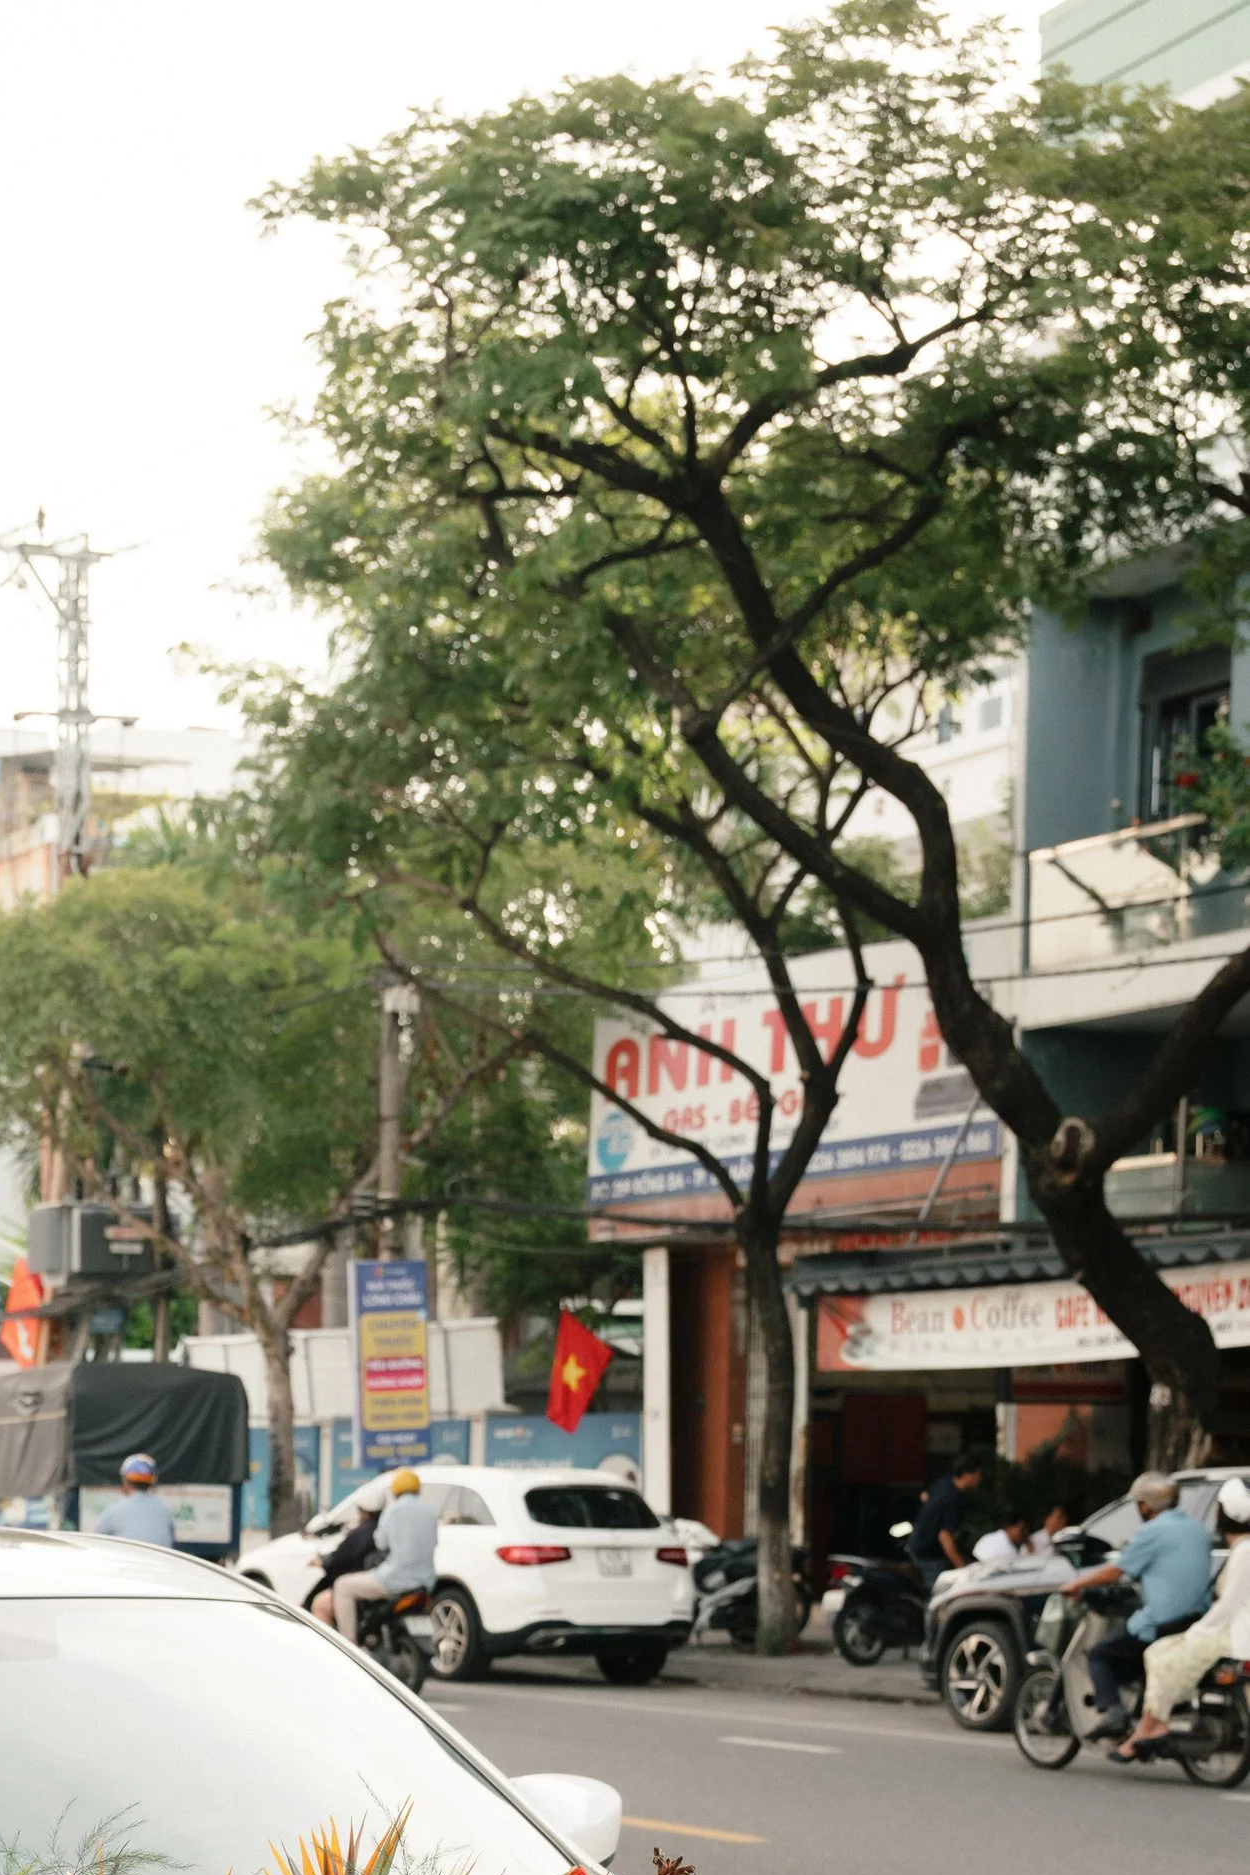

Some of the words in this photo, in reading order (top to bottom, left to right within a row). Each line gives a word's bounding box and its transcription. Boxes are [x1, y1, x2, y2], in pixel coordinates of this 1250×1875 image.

[606, 1018, 736, 1102] ANH
[664, 1104, 706, 1134] GAS
[890, 1300, 945, 1335] Bean
[970, 1293, 1043, 1331] Coffee
